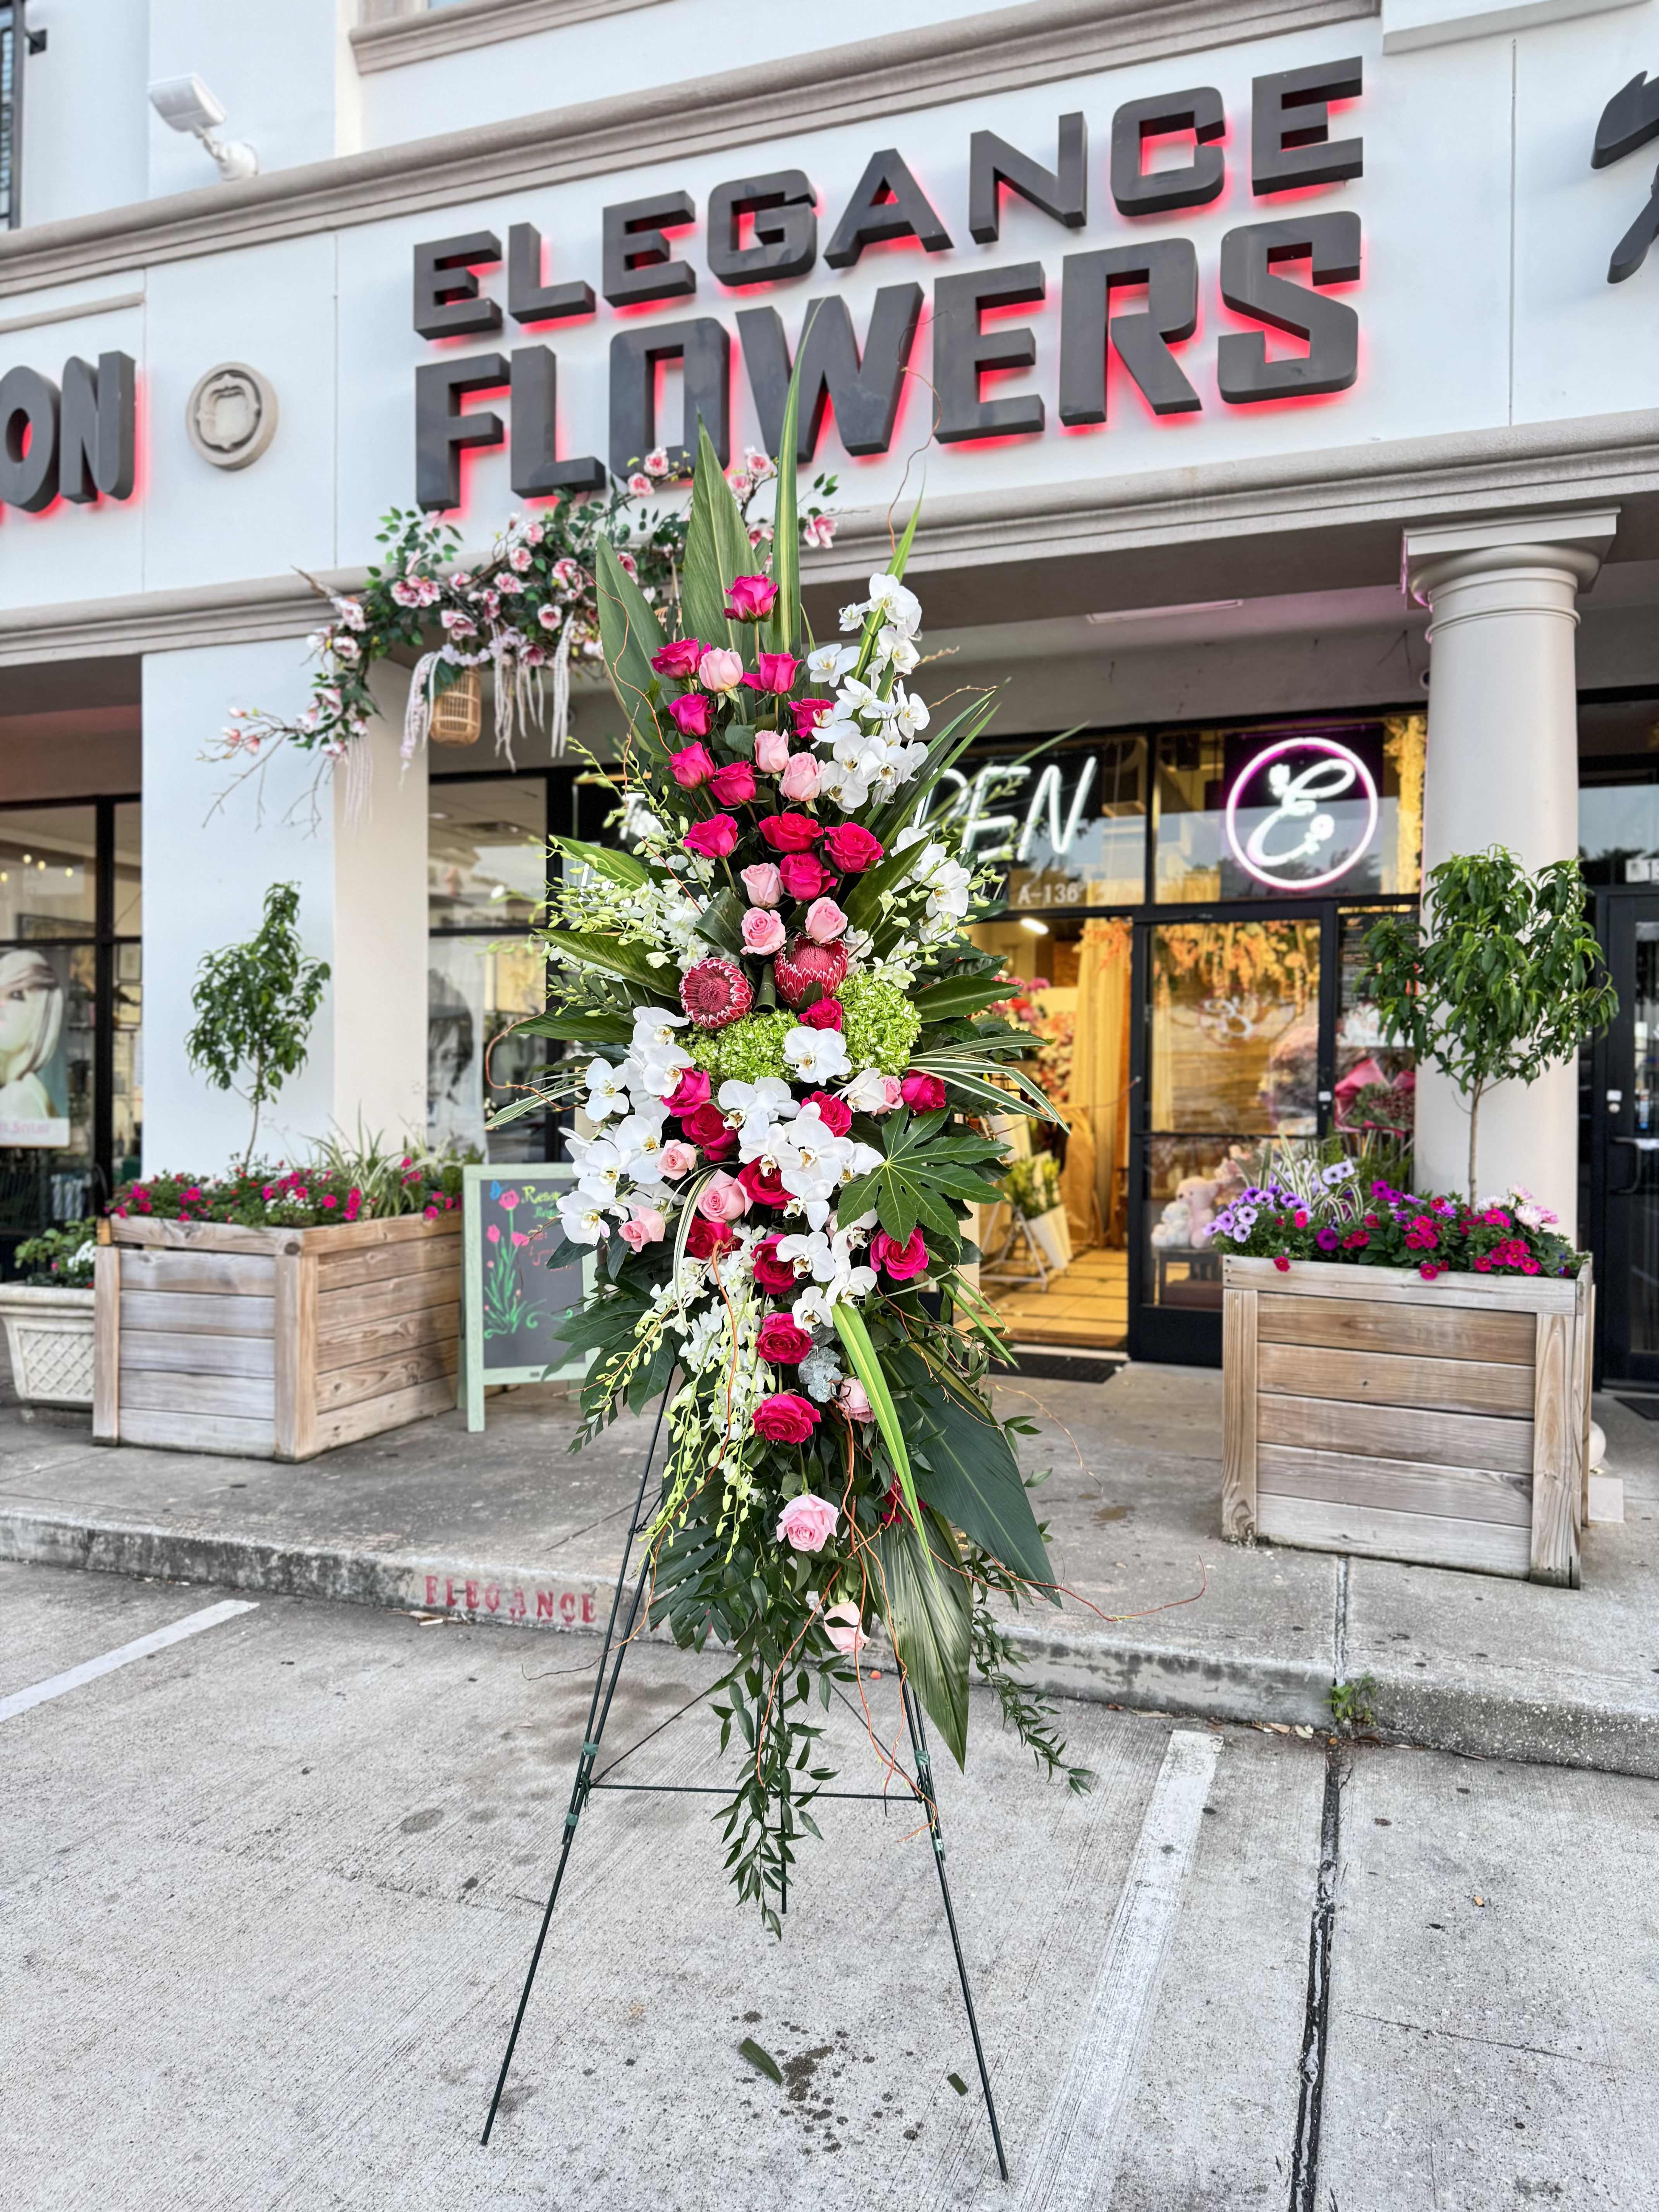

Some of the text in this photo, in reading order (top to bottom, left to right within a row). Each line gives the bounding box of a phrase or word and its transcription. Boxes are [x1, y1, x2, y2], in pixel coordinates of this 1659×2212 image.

[413, 56, 1364, 340] ELEGANCE
[415, 210, 1361, 512] FLOWERS
[1017, 883, 1080, 905] A-136
[425, 1575, 597, 1624] ELEGANCE
